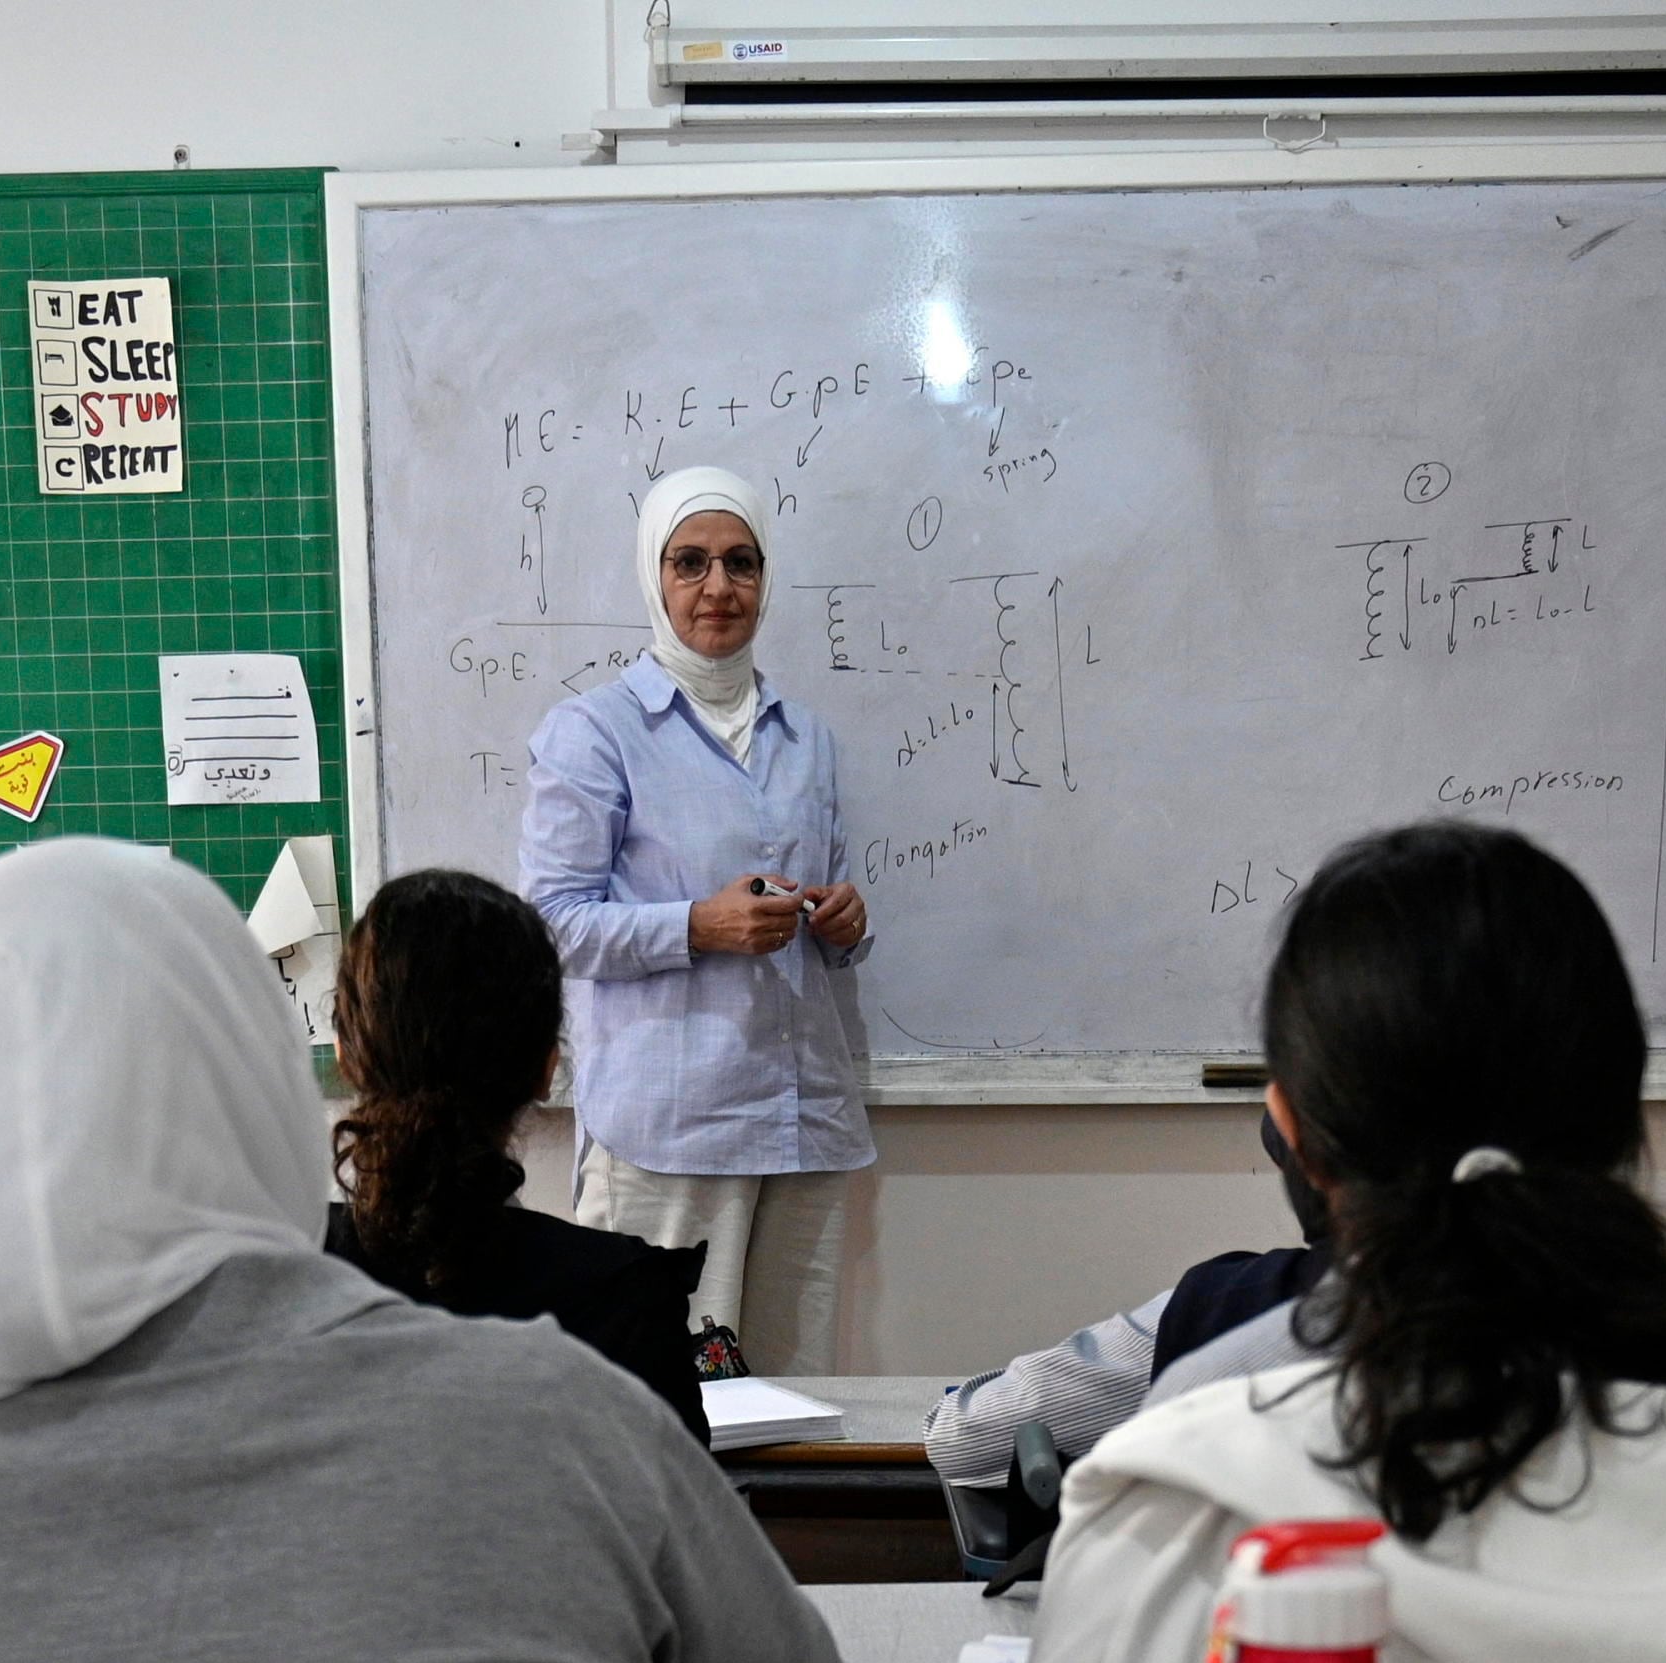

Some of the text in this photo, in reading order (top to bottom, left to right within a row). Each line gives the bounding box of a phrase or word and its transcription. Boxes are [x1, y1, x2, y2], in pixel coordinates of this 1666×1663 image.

[748, 43, 783, 54] USAID
[78, 290, 143, 326] EAT
[82, 336, 174, 383] SLEEP
[80, 392, 178, 437] STUDY
[82, 443, 178, 485] REPEAT
[983, 448, 1057, 493] spring
[1437, 769, 1625, 815] Compression
[865, 818, 988, 886] Elongation
